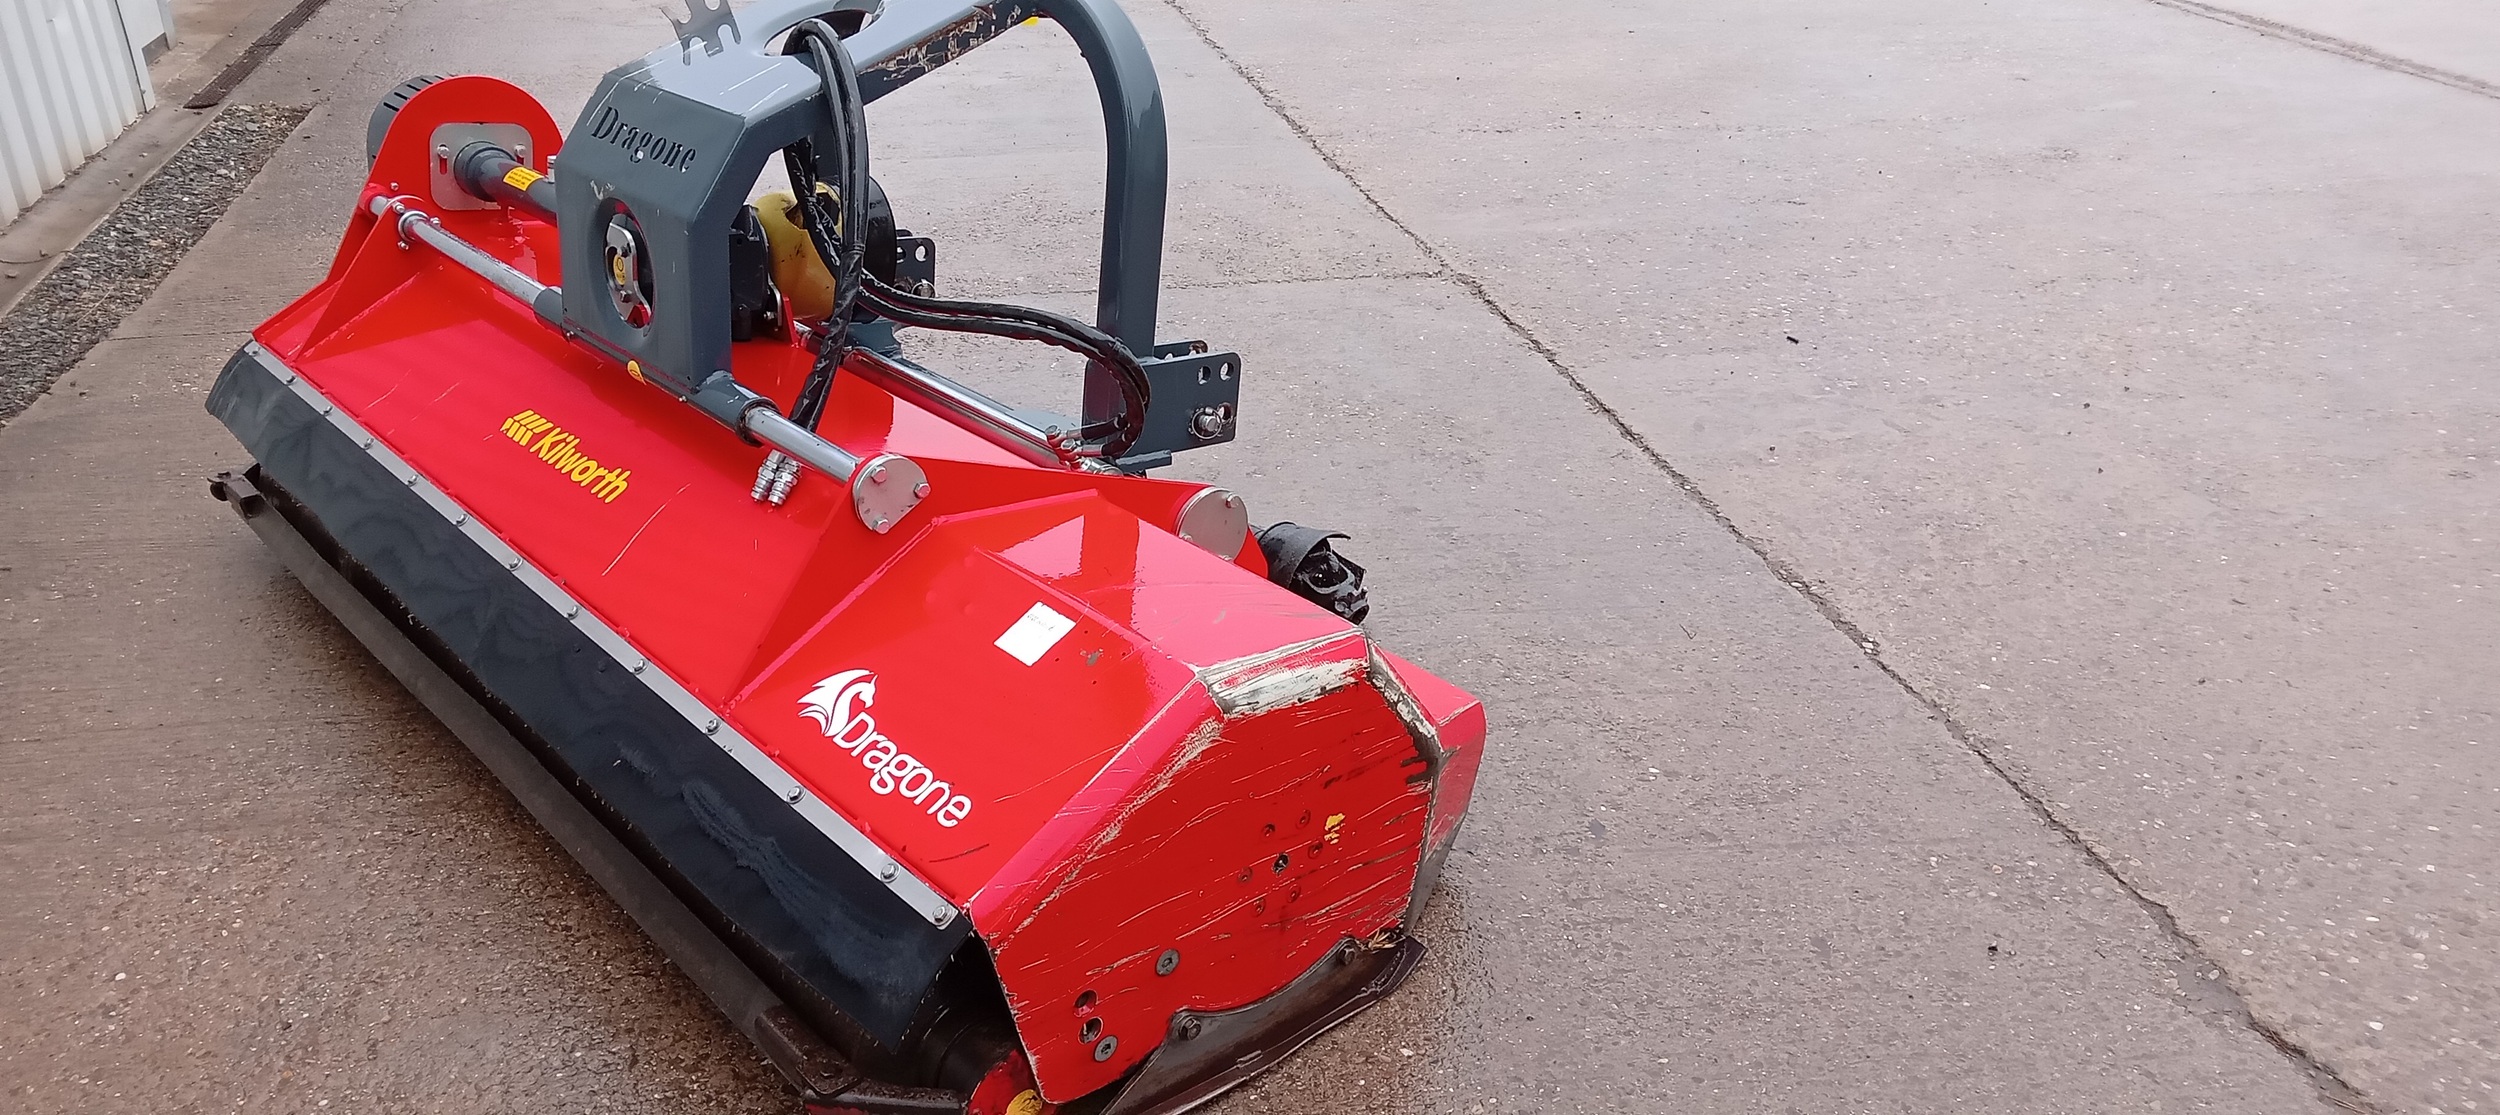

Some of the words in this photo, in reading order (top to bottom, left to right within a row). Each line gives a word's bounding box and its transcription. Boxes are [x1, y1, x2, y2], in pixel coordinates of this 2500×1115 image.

[591, 106, 696, 172] Dragone
[529, 427, 631, 503] Kilworth
[832, 711, 972, 828] Dragone
